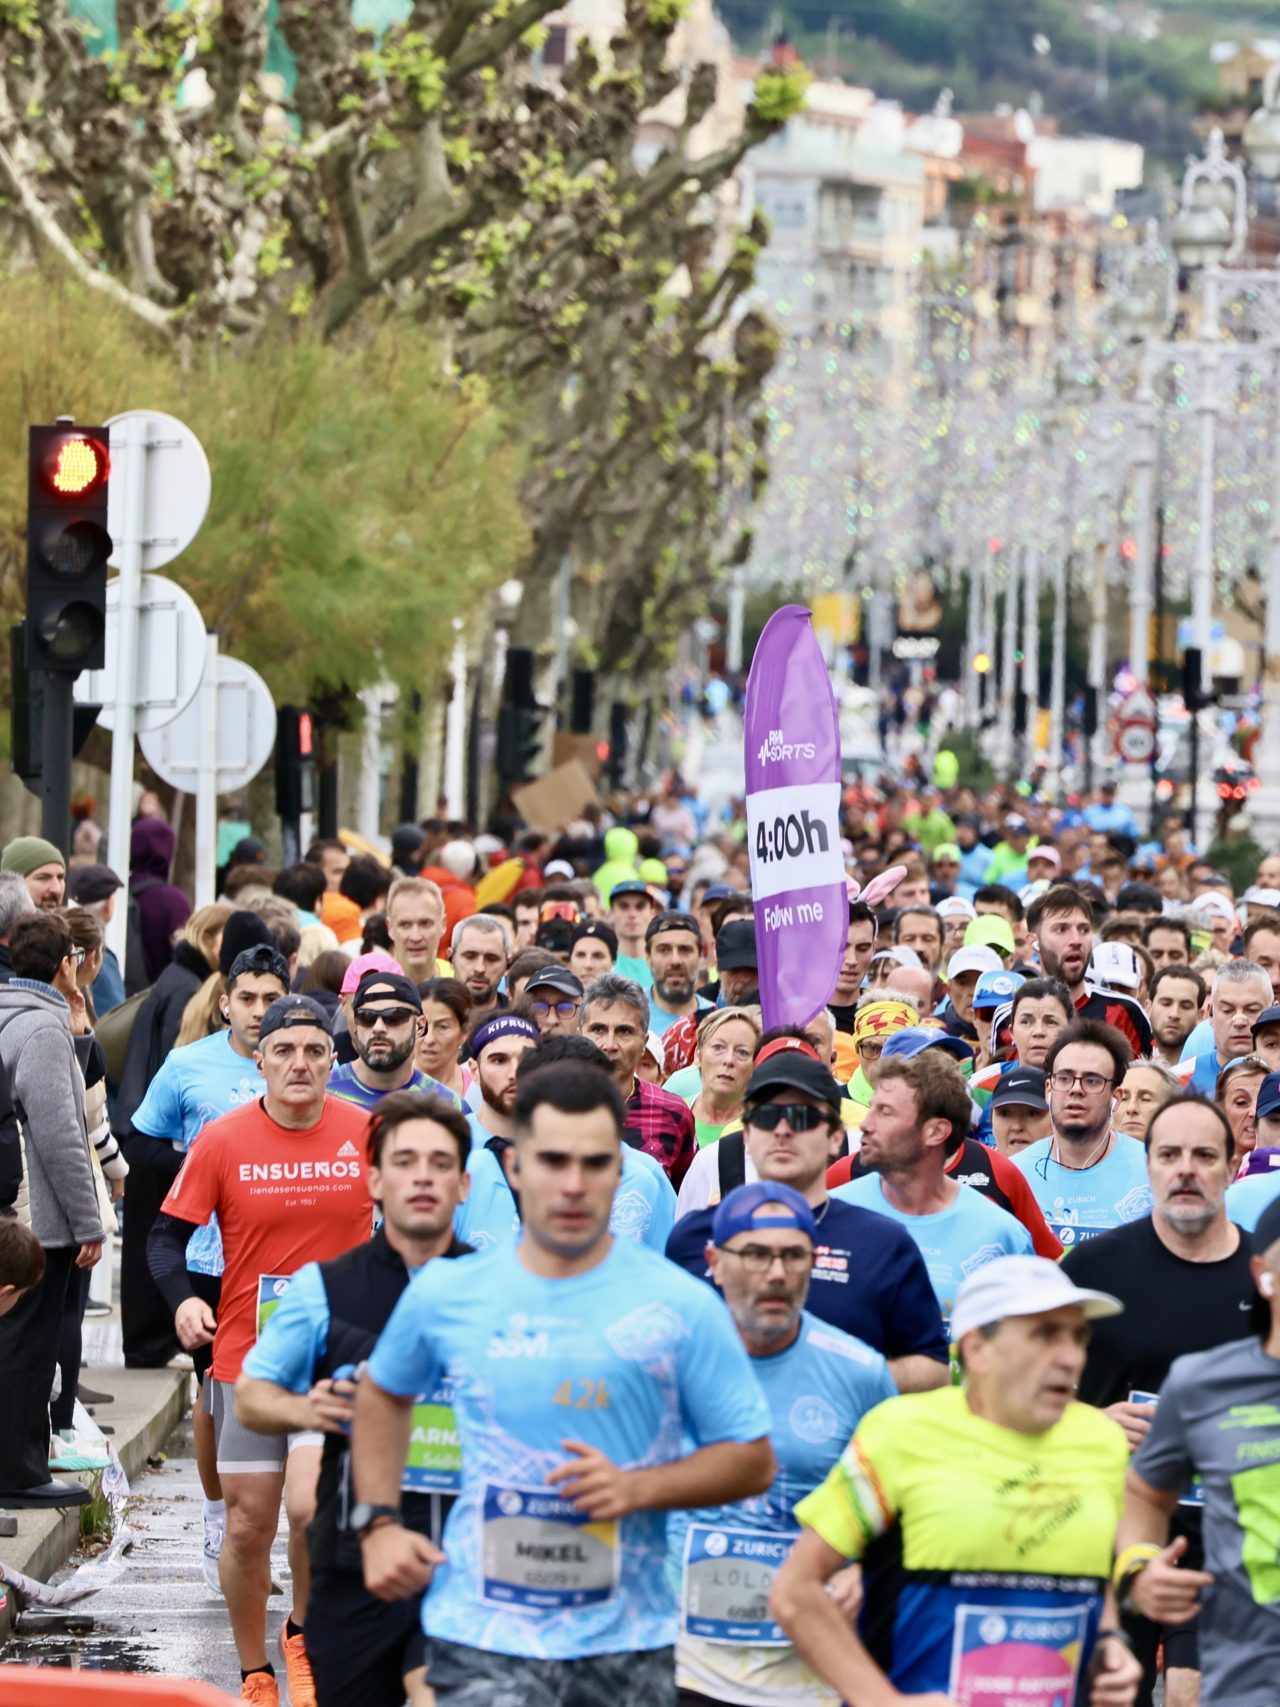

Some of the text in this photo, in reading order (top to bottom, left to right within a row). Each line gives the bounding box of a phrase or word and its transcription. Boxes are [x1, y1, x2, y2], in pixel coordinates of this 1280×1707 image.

[756, 809, 829, 864] 4:00h
[797, 901, 824, 924] me
[487, 1019, 533, 1034] KIPRUN
[239, 1161, 360, 1182] ENSUEÑOS
